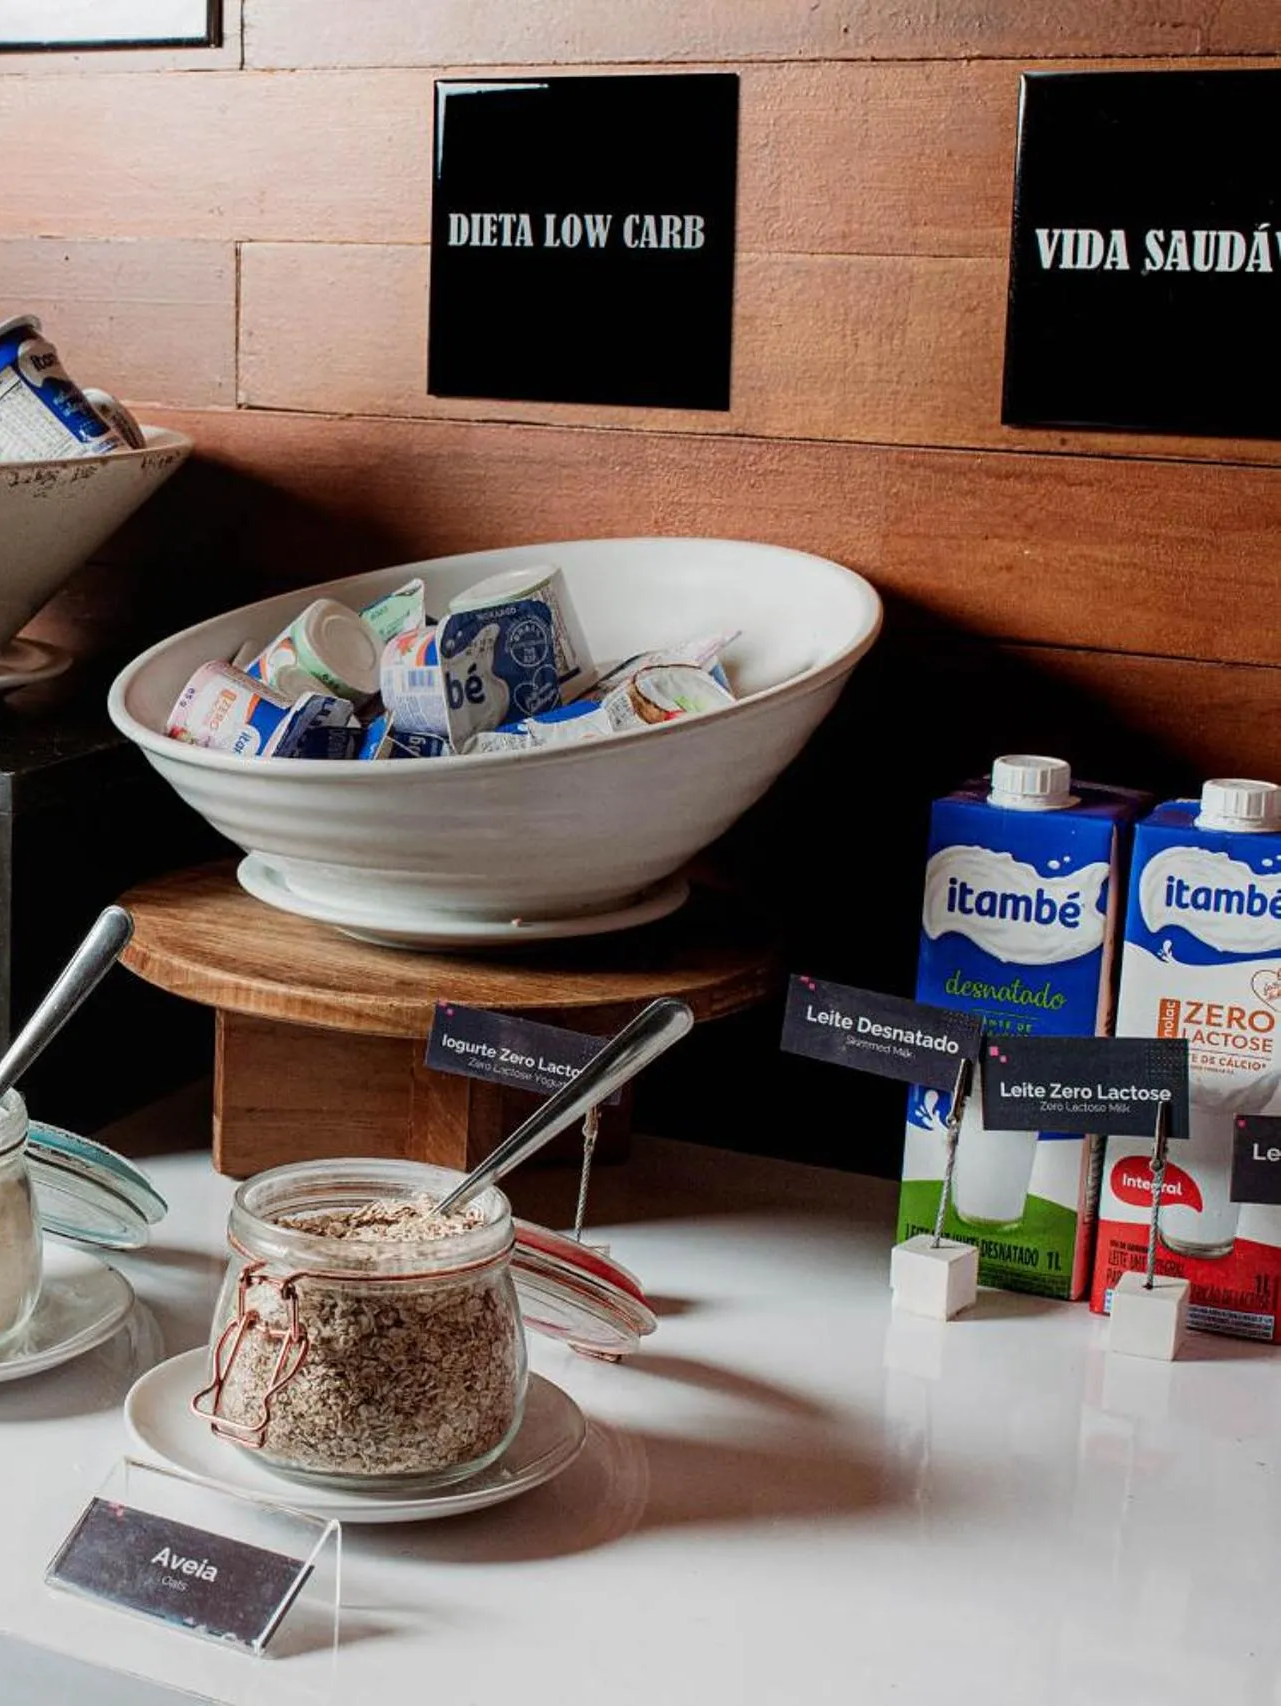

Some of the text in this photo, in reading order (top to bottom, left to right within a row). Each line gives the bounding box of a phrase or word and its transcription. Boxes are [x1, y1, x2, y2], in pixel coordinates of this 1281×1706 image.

[448, 212, 705, 250] DIETA LOW CARB
[1035, 222, 1281, 273] VIDA SAUDÁ
[947, 877, 1081, 929] itambé
[945, 969, 1068, 1010] desnatado
[806, 1004, 960, 1054] Leite Desnatado
[1183, 1000, 1275, 1033] ZERO
[441, 1034, 583, 1080] Iogurte Zero Lacto
[1182, 1027, 1274, 1054] LACTOSE
[1000, 1081, 1172, 1101] Leite Zero Lactose
[981, 1238, 1039, 1267] DESNATADO
[1046, 1251, 1062, 1271] 1L
[151, 1547, 218, 1584] Aveia
